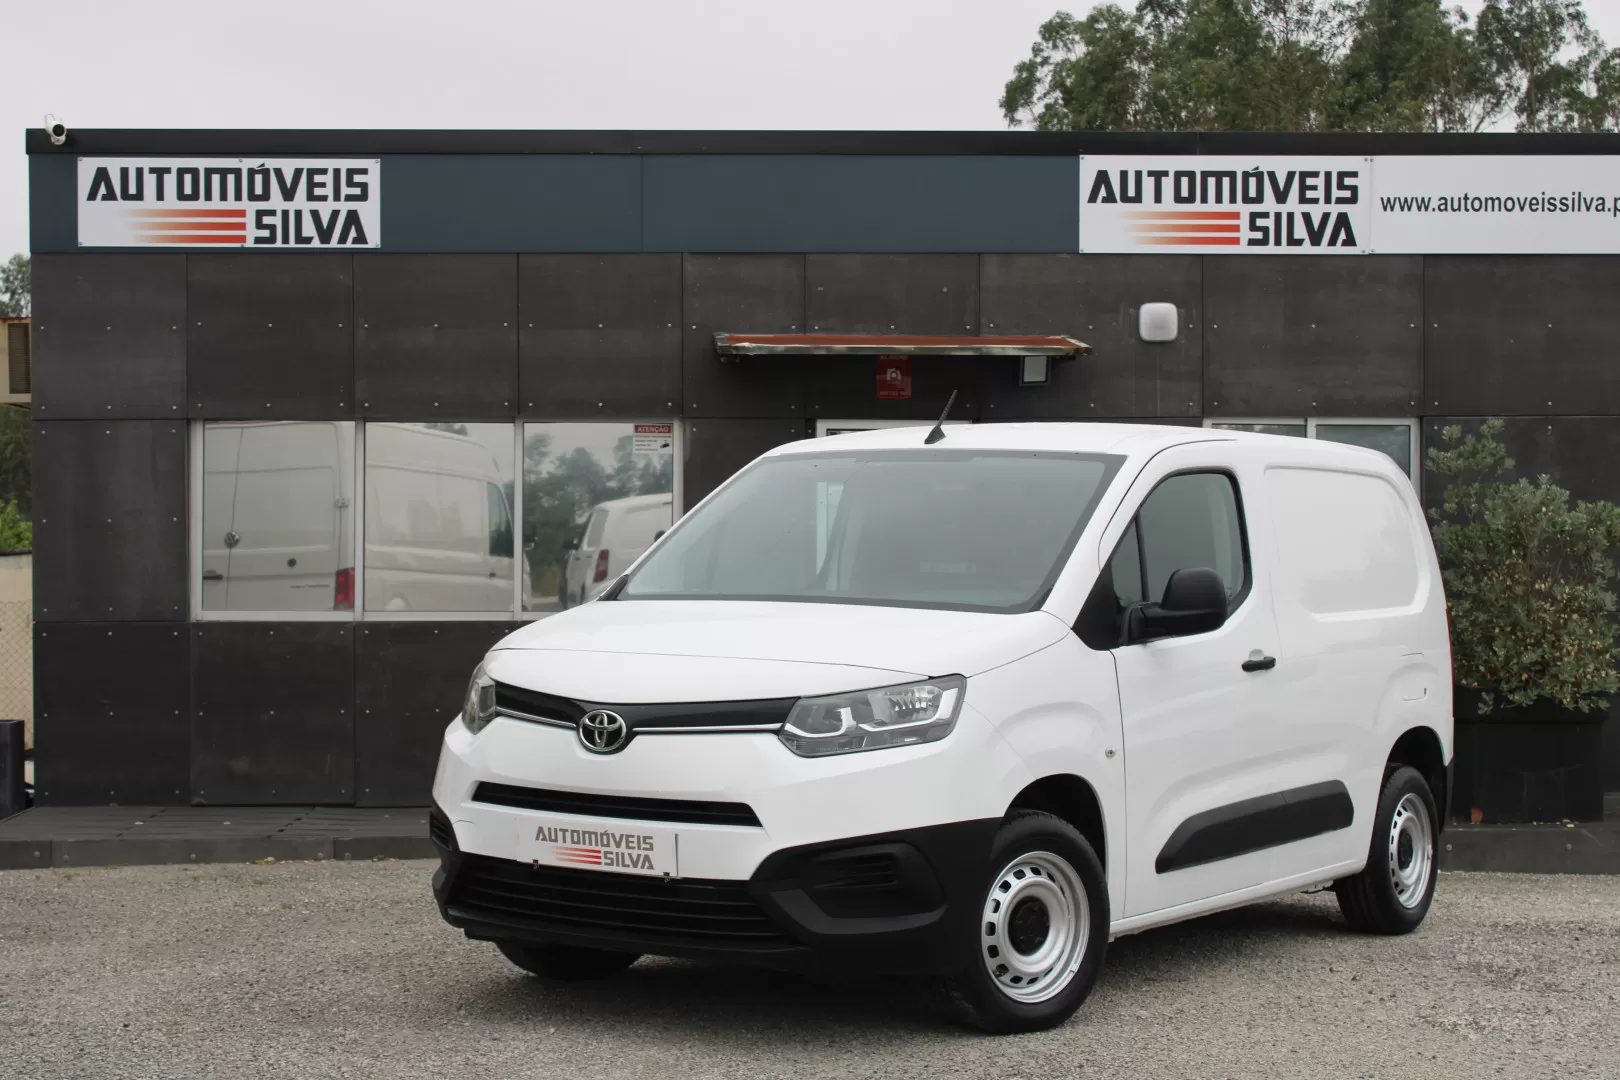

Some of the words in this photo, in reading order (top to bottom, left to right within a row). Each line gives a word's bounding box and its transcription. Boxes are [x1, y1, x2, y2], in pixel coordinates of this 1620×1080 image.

[86, 162, 369, 202] AUTOMÓVEIS
[1086, 165, 1359, 205] AUTOMÓVEIS
[253, 209, 369, 245] SILVA
[1247, 211, 1358, 247] SILVA
[535, 826, 654, 851] AUTOMÓVEIS
[603, 850, 655, 870] SILVA
